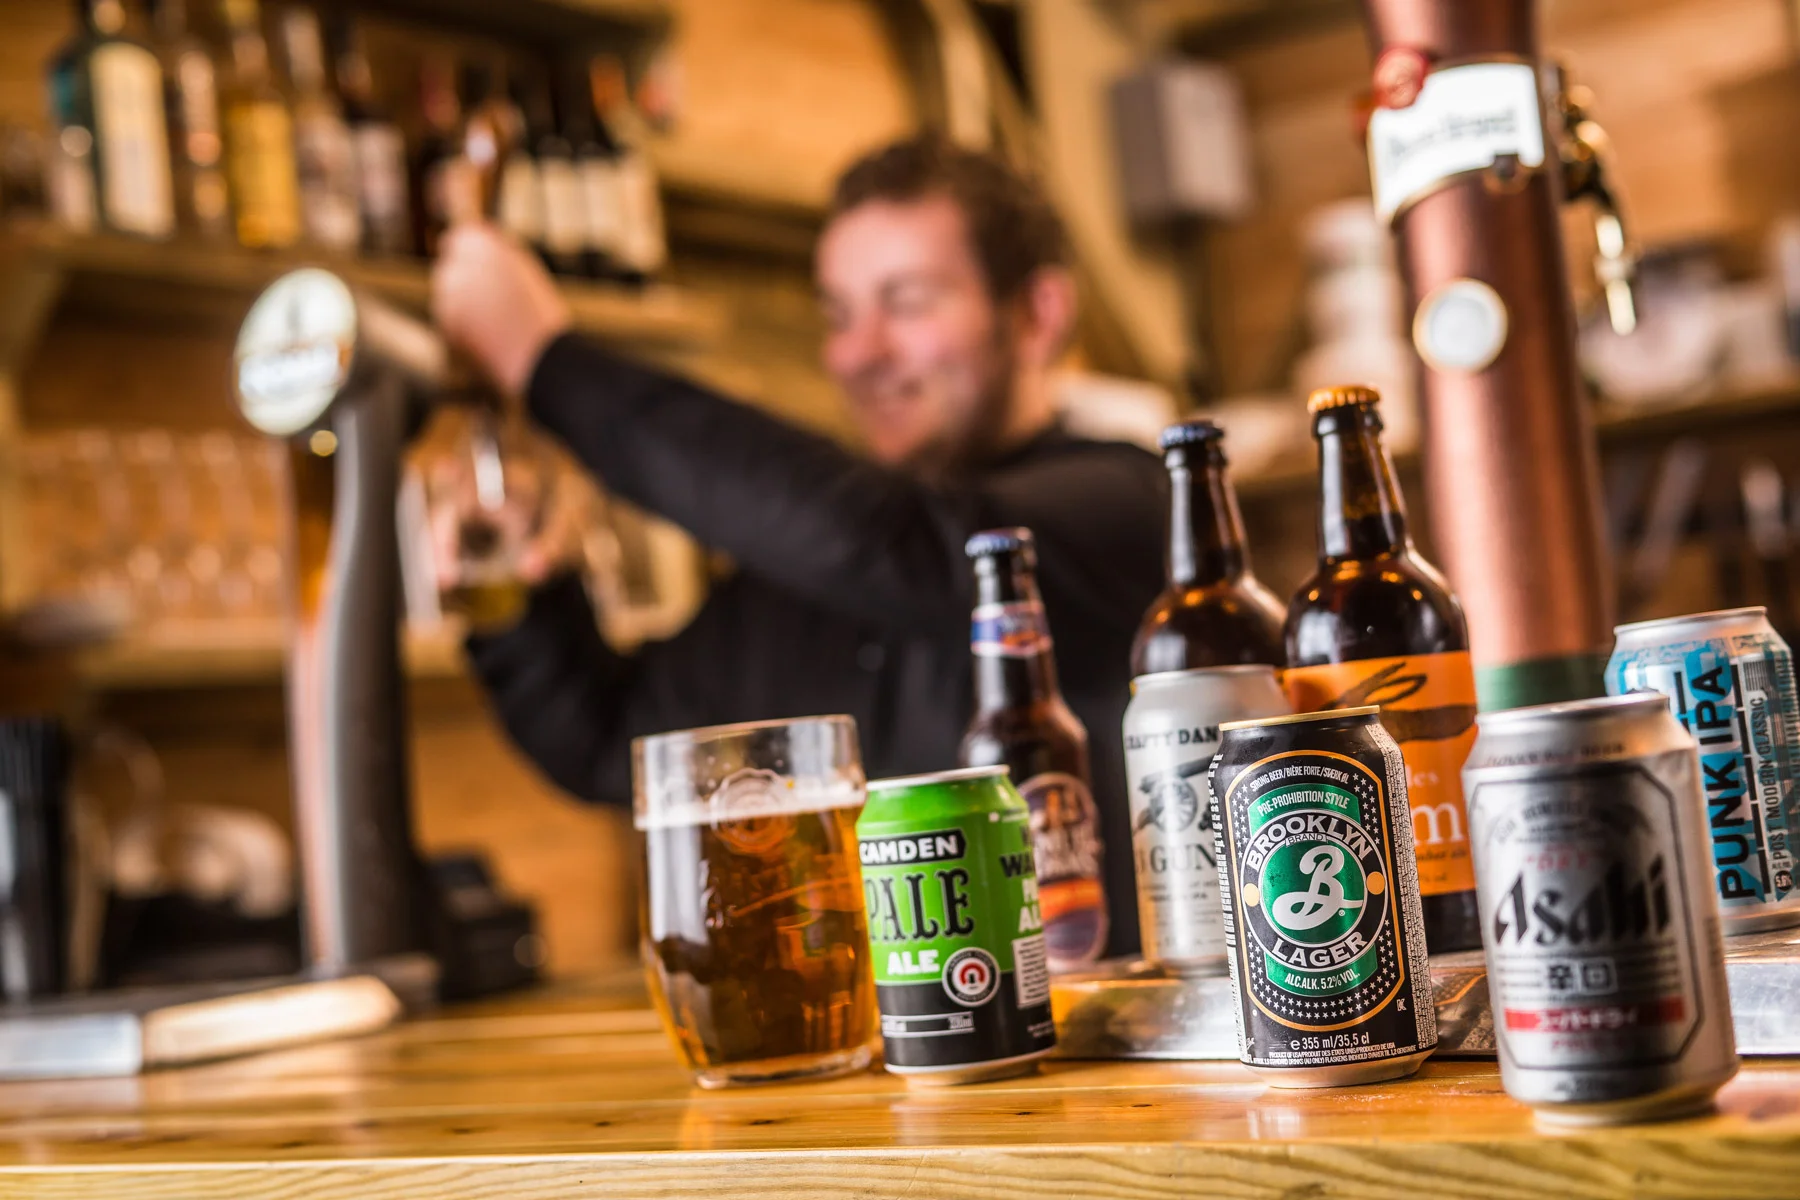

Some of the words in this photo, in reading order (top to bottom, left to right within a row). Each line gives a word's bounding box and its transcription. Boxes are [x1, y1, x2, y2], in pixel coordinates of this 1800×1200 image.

[1692, 665, 1733, 746] IPA
[1751, 696, 1771, 755] CLASSIC
[1250, 774, 1270, 792] STRONG
[1759, 760, 1782, 820] MODERN
[1257, 790, 1325, 817] PRE-PROHIBITION
[1324, 791, 1351, 809] STYLE
[1246, 814, 1372, 872] BROOKLYN
[1287, 833, 1324, 844] BRAND
[1703, 758, 1756, 900] PUNK
[1768, 826, 1788, 861] POST
[859, 835, 958, 864] CAMDEN
[1150, 843, 1218, 874] GUN
[864, 868, 974, 940] PALE
[1493, 854, 1671, 947] Asahi
[887, 949, 940, 976] ALE
[1271, 931, 1368, 968] LAGER
[1320, 975, 1342, 990] 5.2%
[1340, 969, 1361, 984] VOL.
[1301, 1037, 1320, 1050] 355
[1322, 1033, 1359, 1049] ml/35,5
[1361, 1031, 1370, 1045] cl
